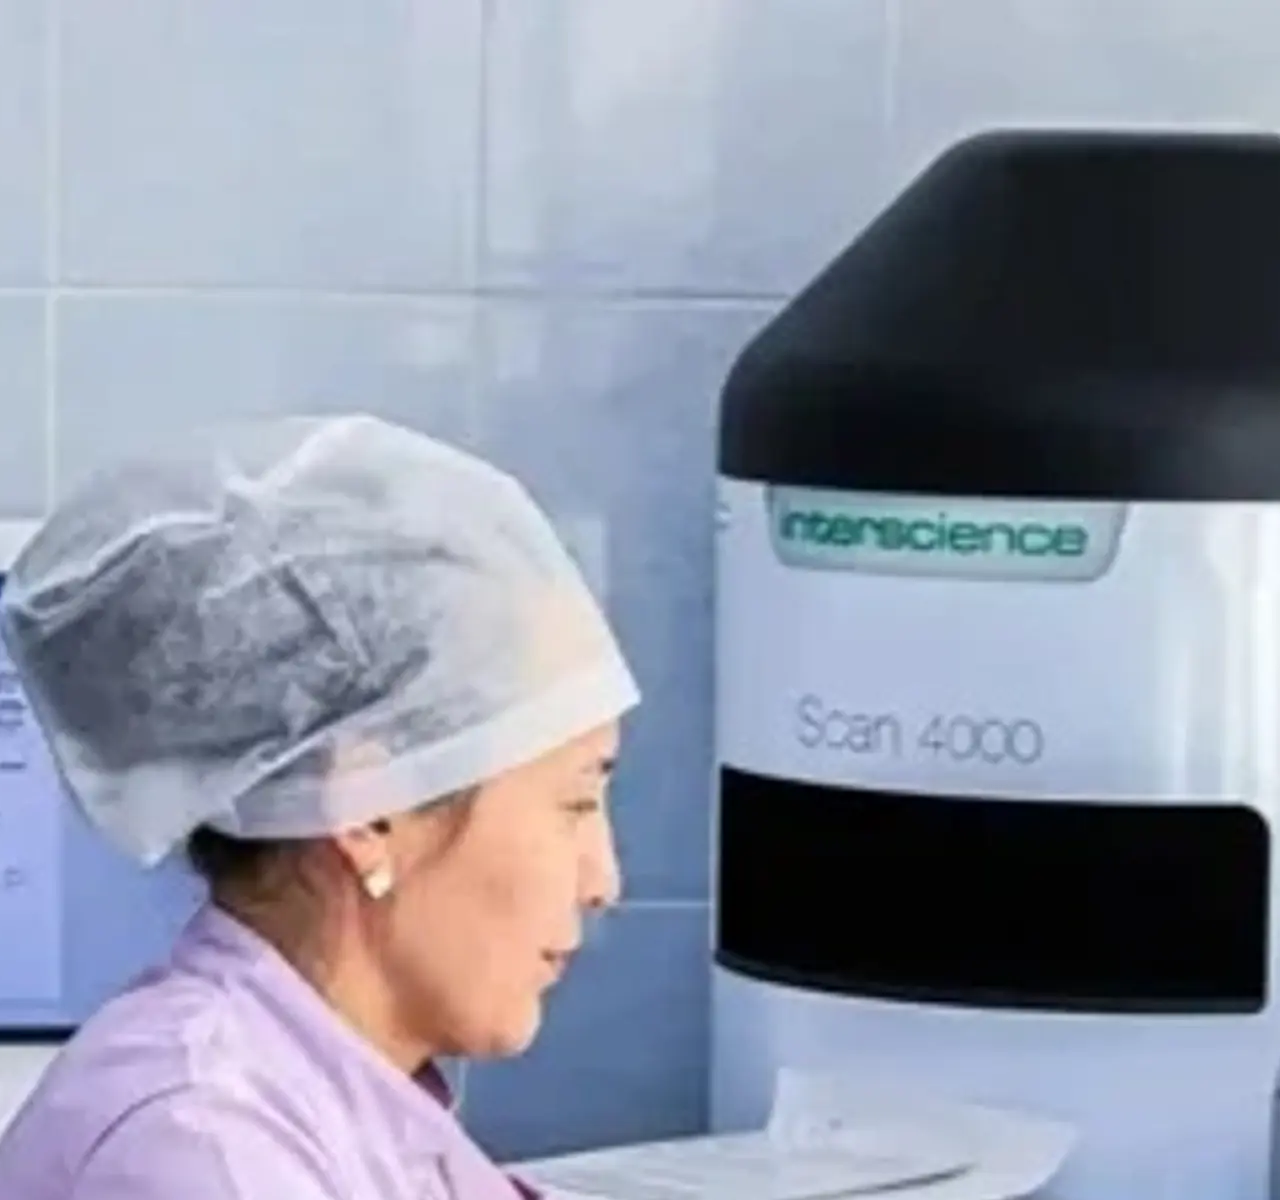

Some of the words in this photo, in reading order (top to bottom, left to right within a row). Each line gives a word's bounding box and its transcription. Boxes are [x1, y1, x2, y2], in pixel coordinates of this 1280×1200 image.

[779, 510, 1089, 557] interscience
[796, 693, 903, 757] Scan
[918, 713, 1045, 765] 4000
